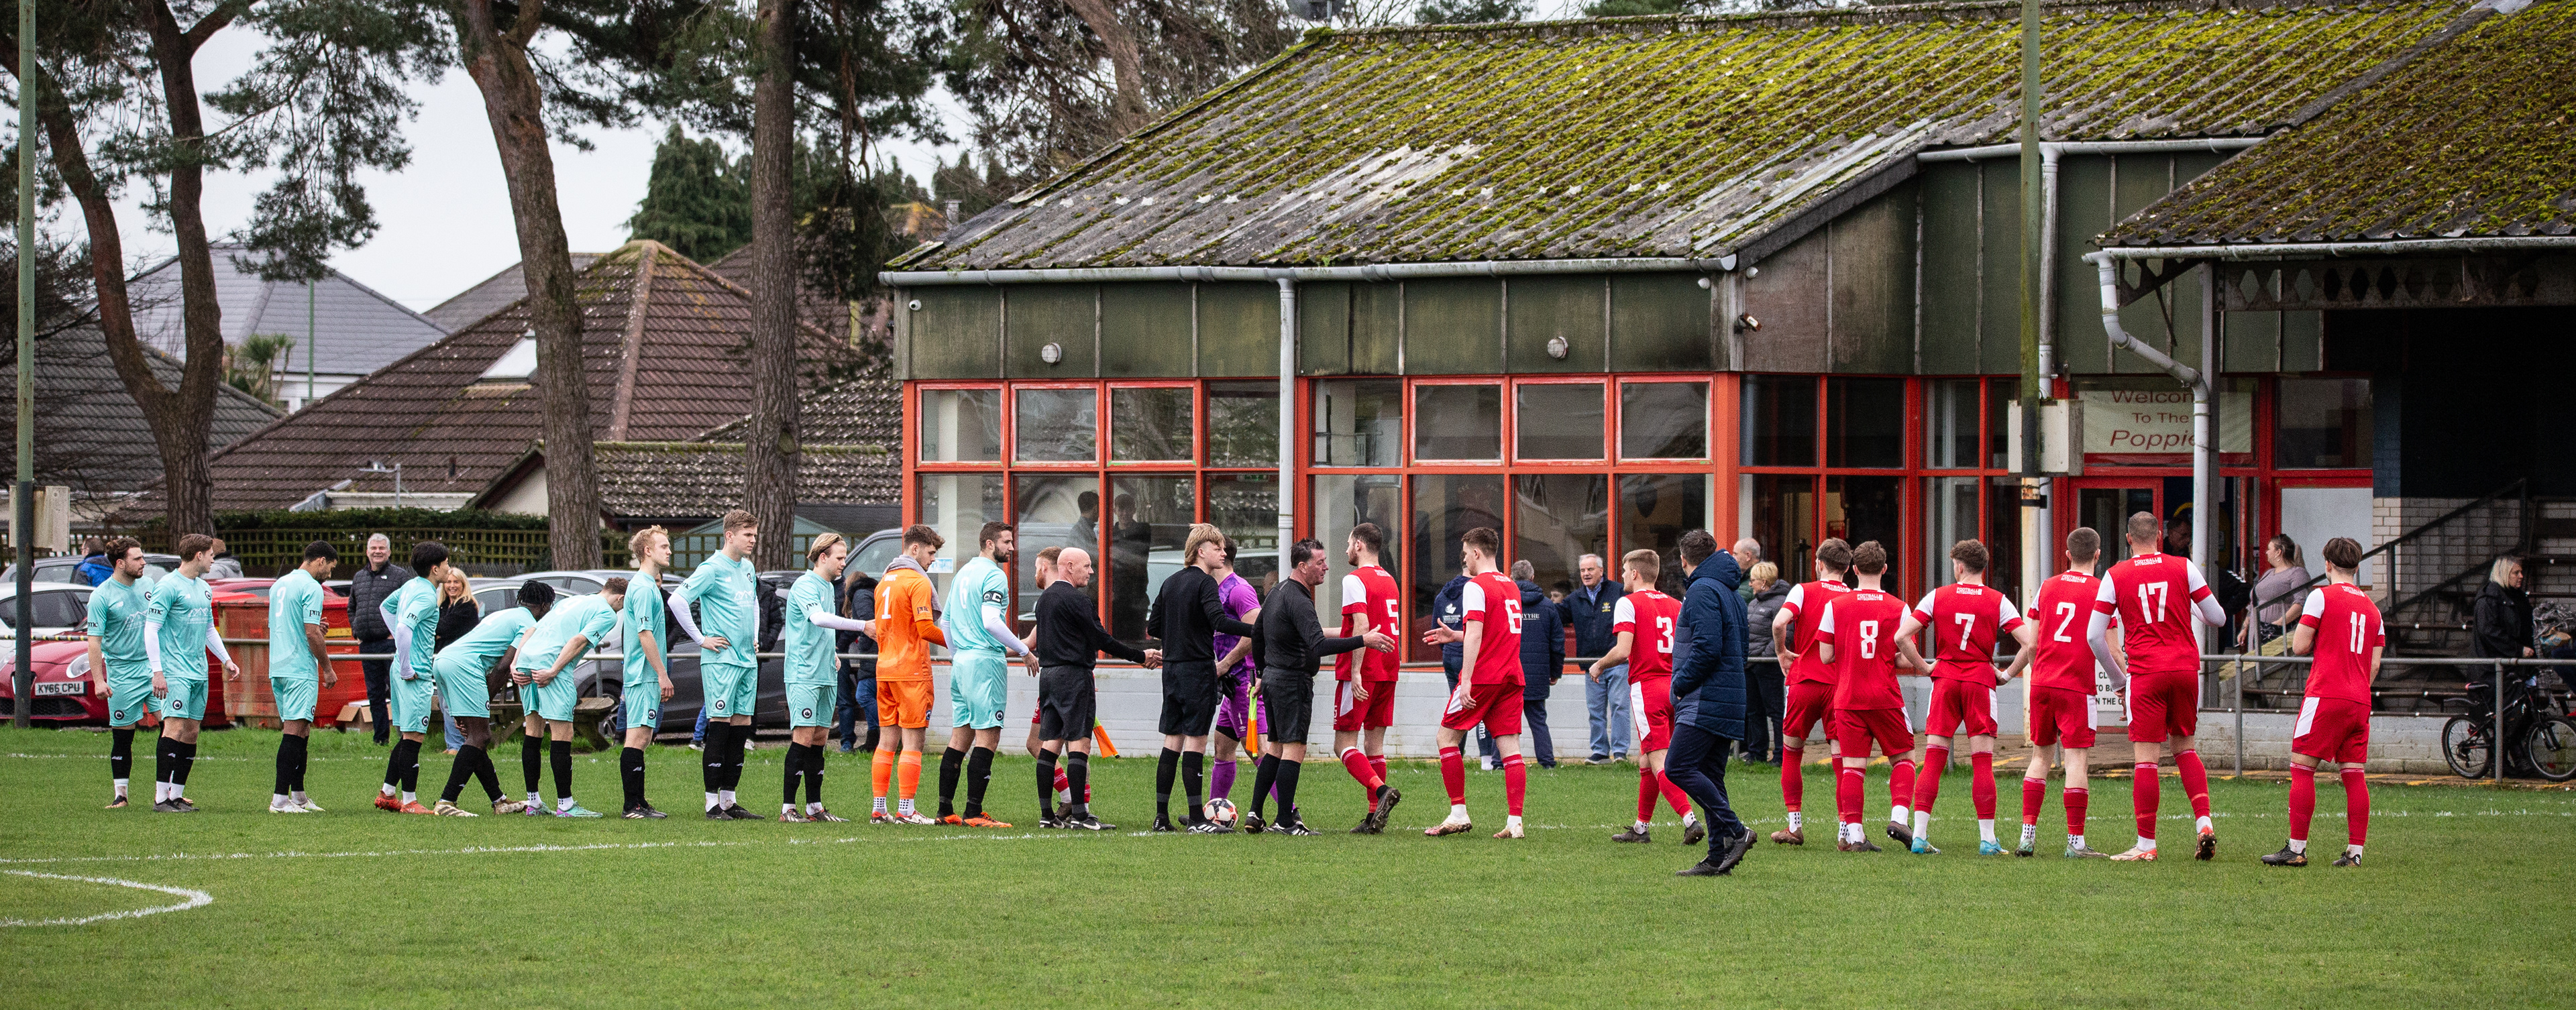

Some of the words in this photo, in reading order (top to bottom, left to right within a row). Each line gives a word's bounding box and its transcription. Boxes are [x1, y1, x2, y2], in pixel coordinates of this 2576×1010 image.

[2131, 412, 2151, 423] To
[2157, 412, 2189, 423] The
[275, 586, 286, 618] 3
[881, 586, 892, 619] 1
[959, 576, 971, 610] 6
[2139, 581, 2169, 624] 17
[1386, 600, 1399, 635] 5
[1505, 599, 1521, 634] 6
[1955, 613, 1976, 651] 7
[2054, 602, 2076, 642] 2
[2350, 611, 2366, 655] 11
[1656, 616, 1673, 653] 3
[1860, 620, 1878, 659] 8
[38, 684, 60, 693] KY66
[62, 683, 80, 692] CPU
